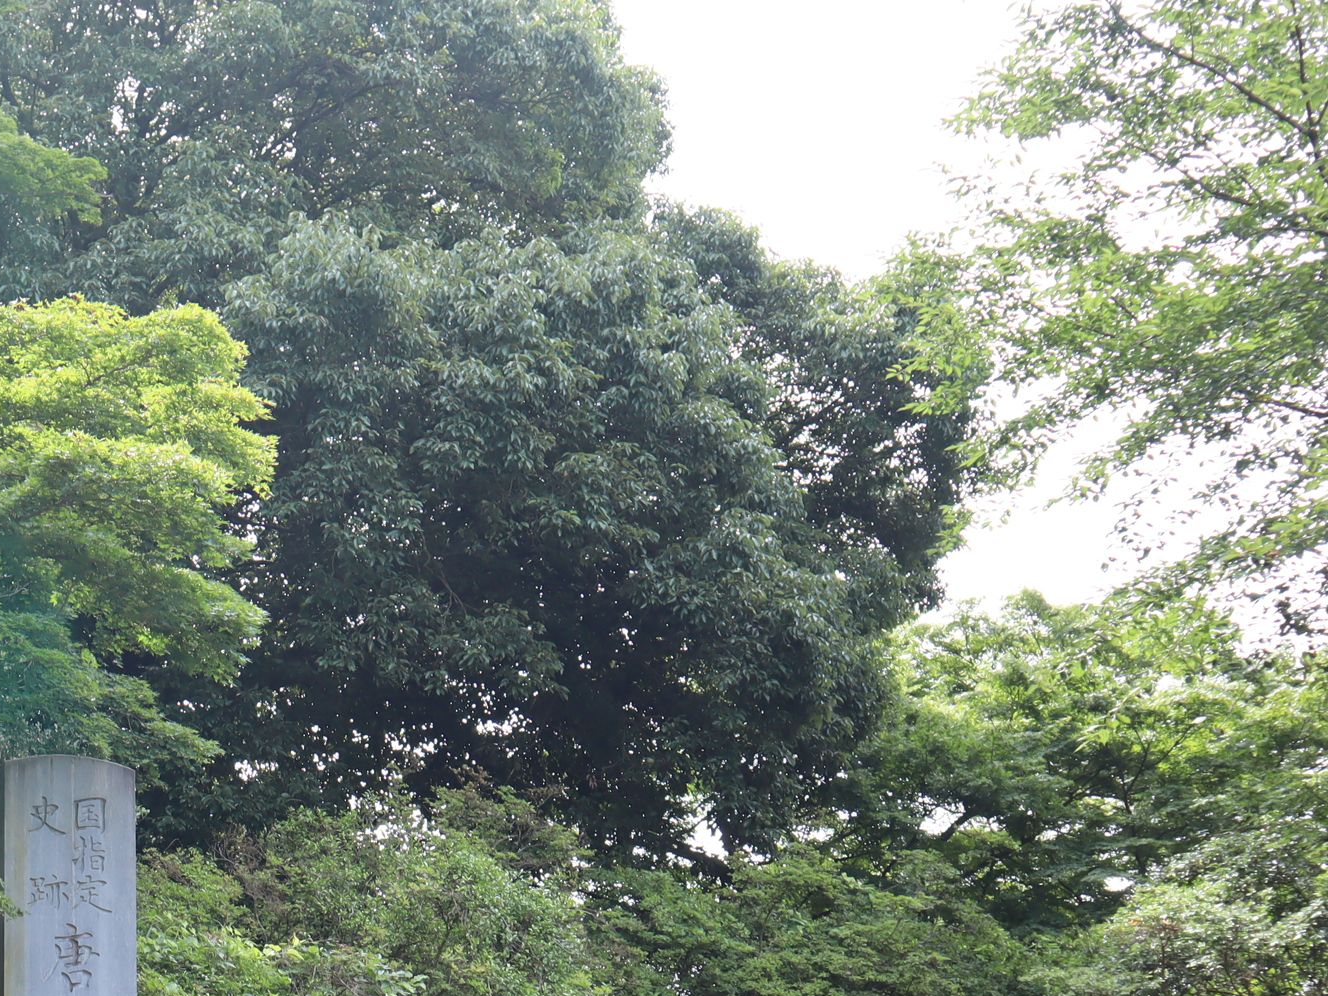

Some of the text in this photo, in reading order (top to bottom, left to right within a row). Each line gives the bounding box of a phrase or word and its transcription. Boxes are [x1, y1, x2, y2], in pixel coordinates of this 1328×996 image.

[27, 795, 70, 909] 史跡
[72, 796, 113, 913] 国指定
